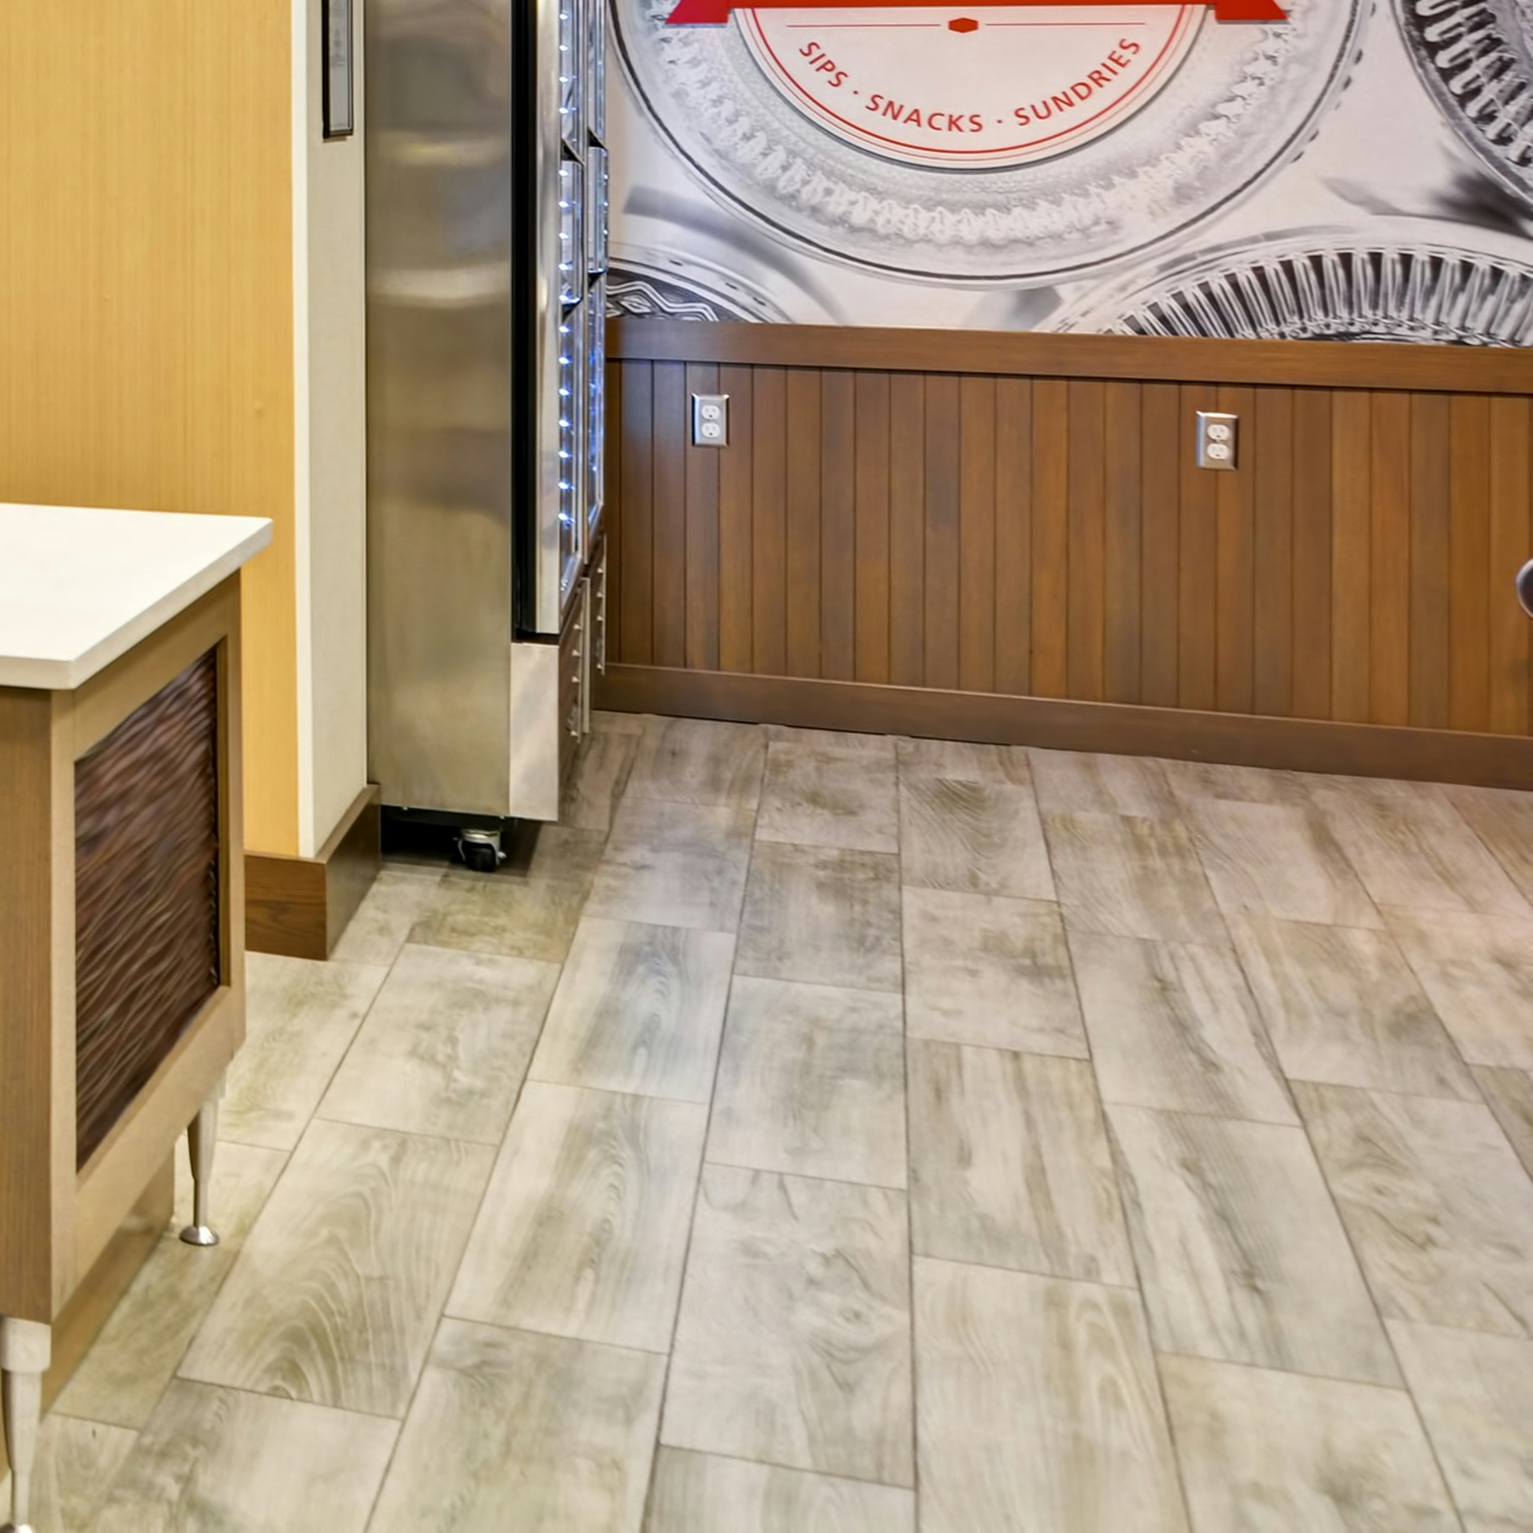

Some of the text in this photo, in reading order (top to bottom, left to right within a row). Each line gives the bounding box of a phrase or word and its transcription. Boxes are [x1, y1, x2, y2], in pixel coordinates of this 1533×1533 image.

[799, 38, 1141, 133] SIPS SNACKS SUNDRIES
